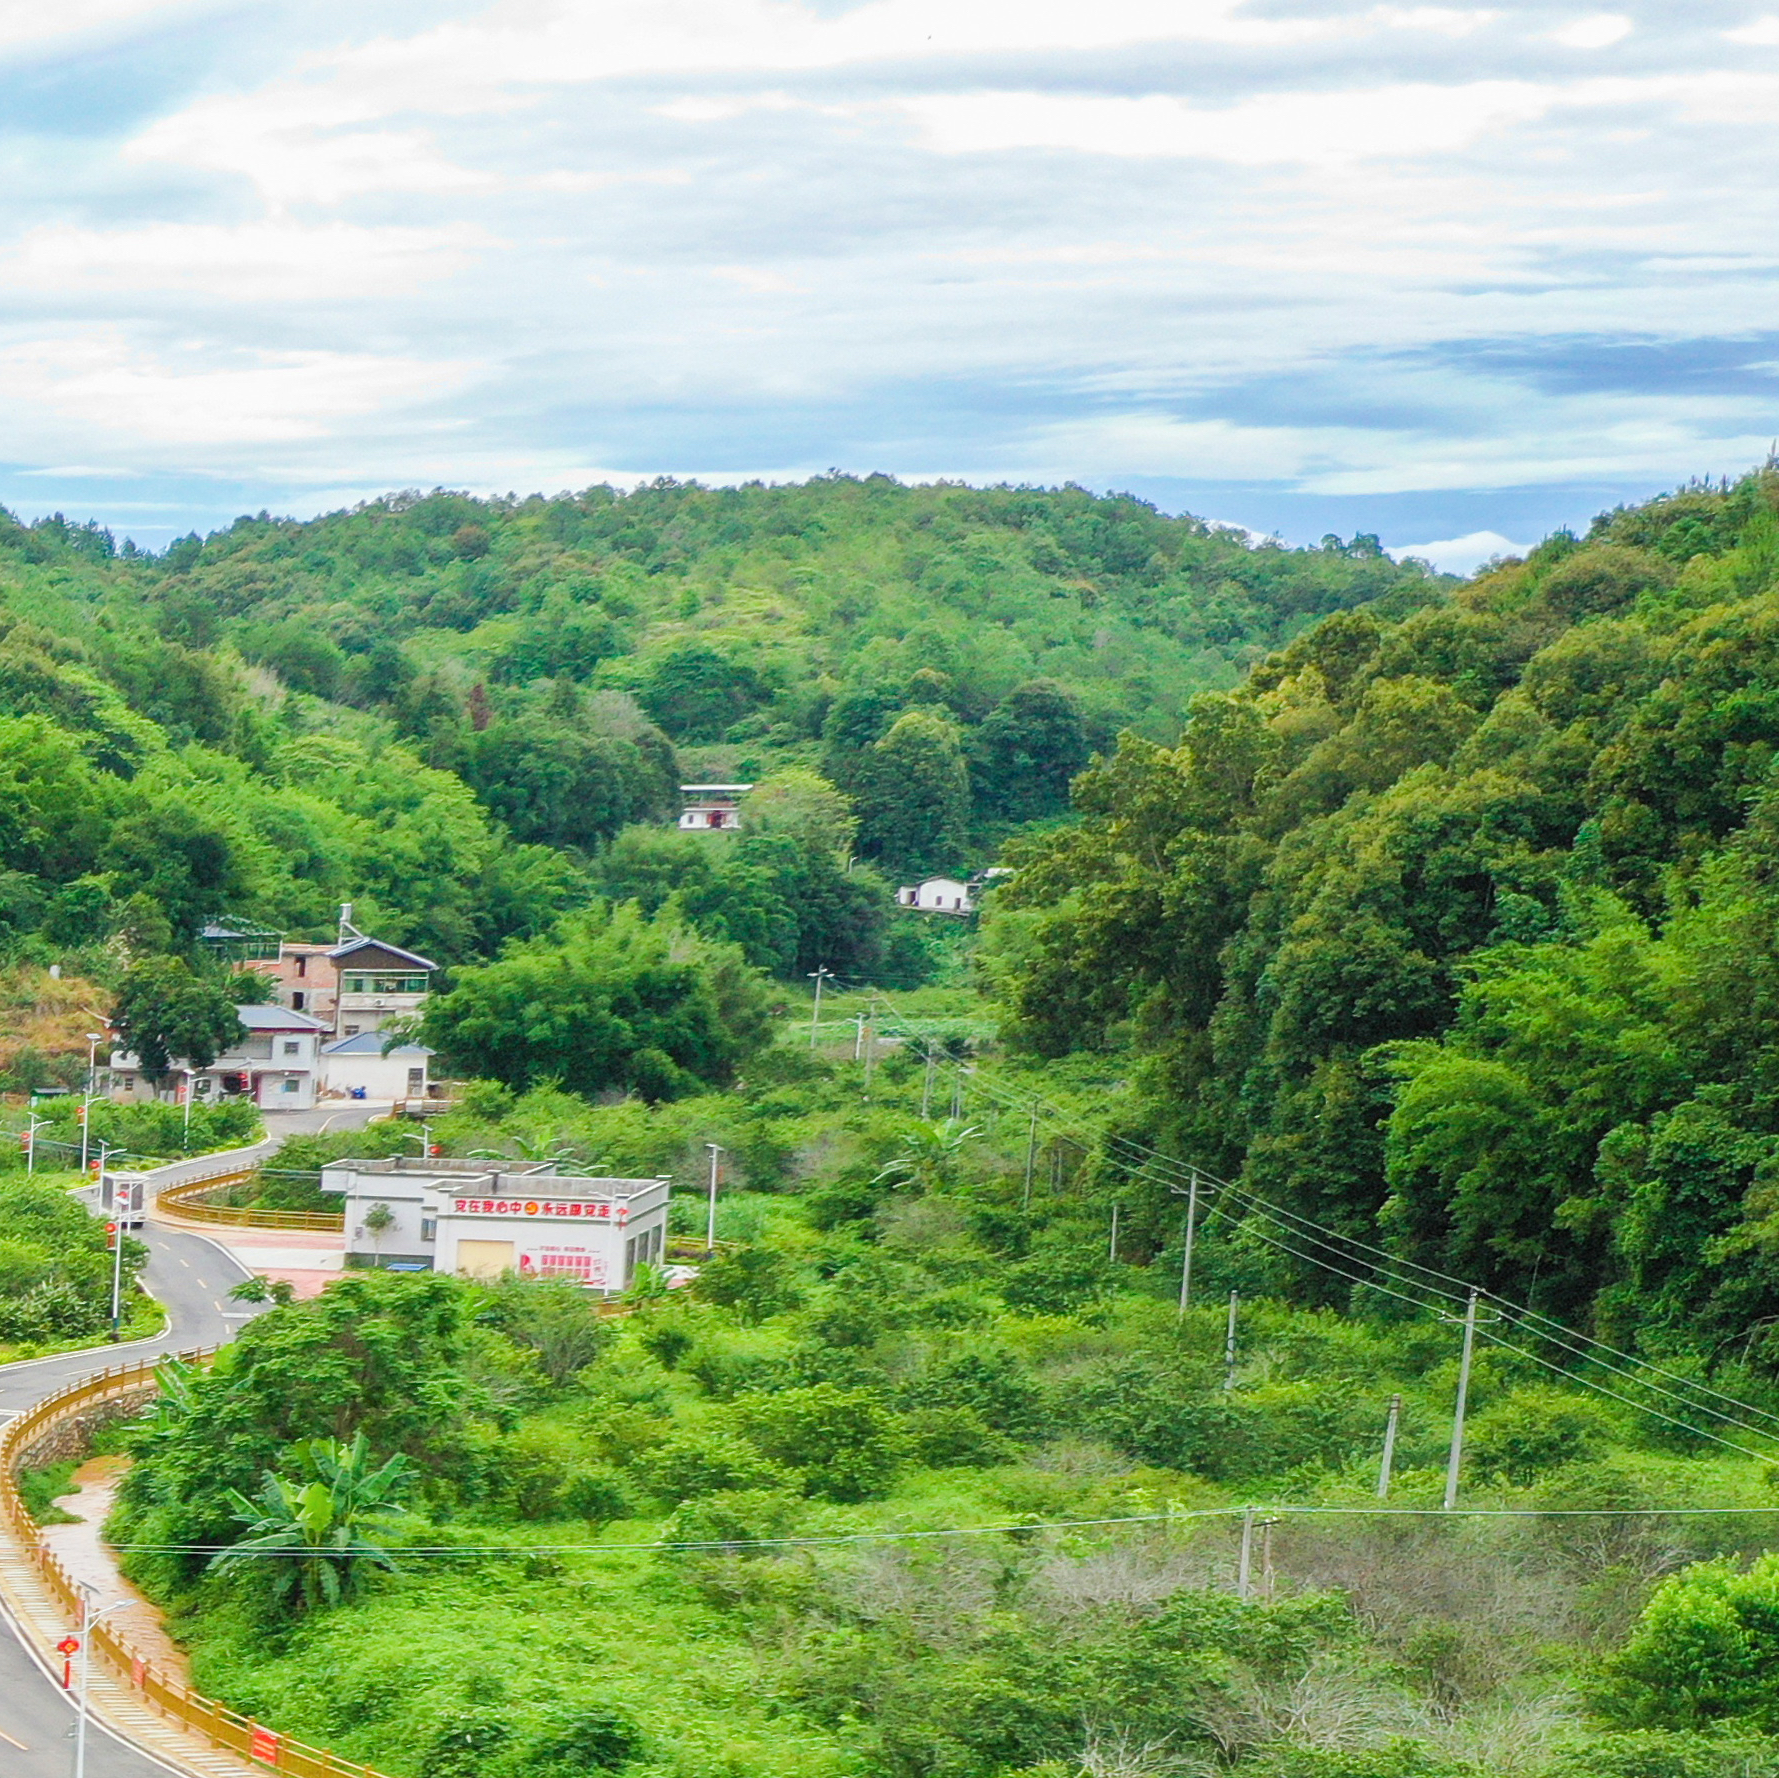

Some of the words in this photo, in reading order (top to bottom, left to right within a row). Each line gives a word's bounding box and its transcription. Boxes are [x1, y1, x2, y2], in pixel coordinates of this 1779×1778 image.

[454, 1200, 522, 1215] 党在我心中
